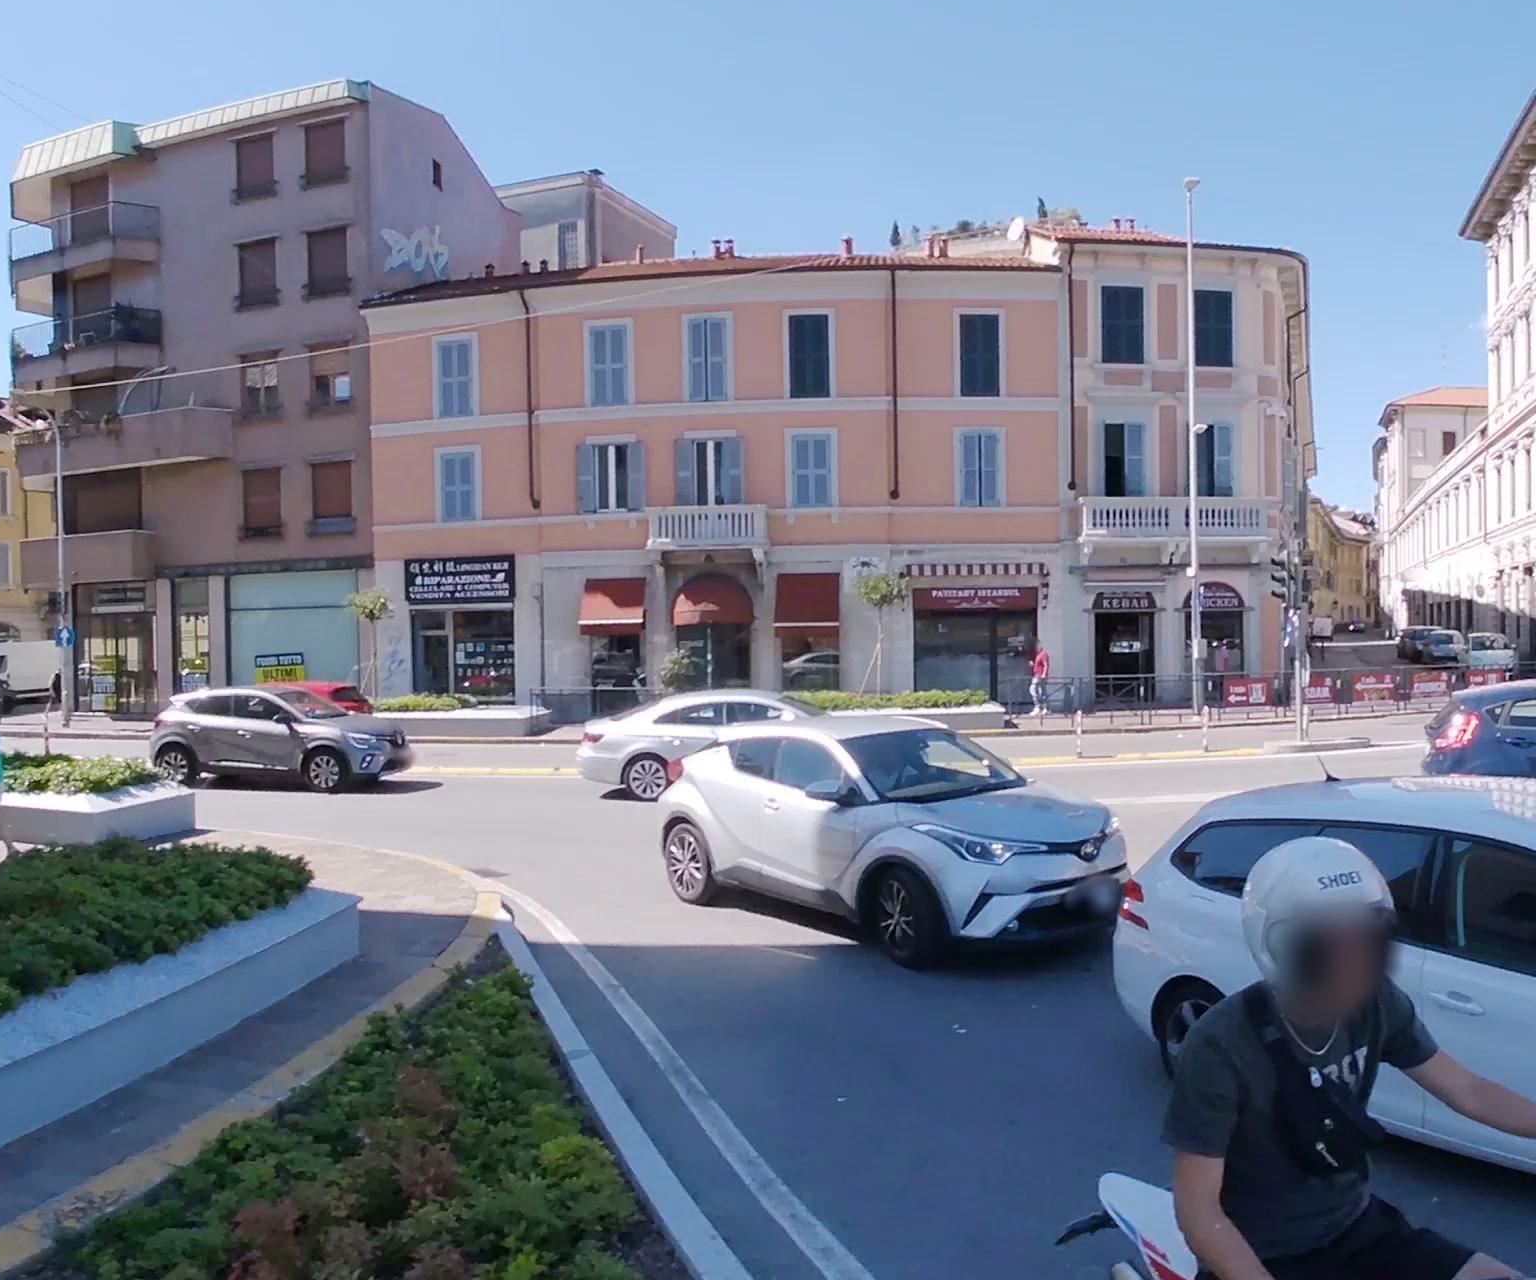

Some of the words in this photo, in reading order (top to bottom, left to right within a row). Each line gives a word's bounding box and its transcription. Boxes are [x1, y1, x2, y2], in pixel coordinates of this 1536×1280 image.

[1102, 599, 1149, 608] KEBAB
[262, 668, 298, 680] ULTIMI
[1317, 870, 1363, 891] SHOEI
